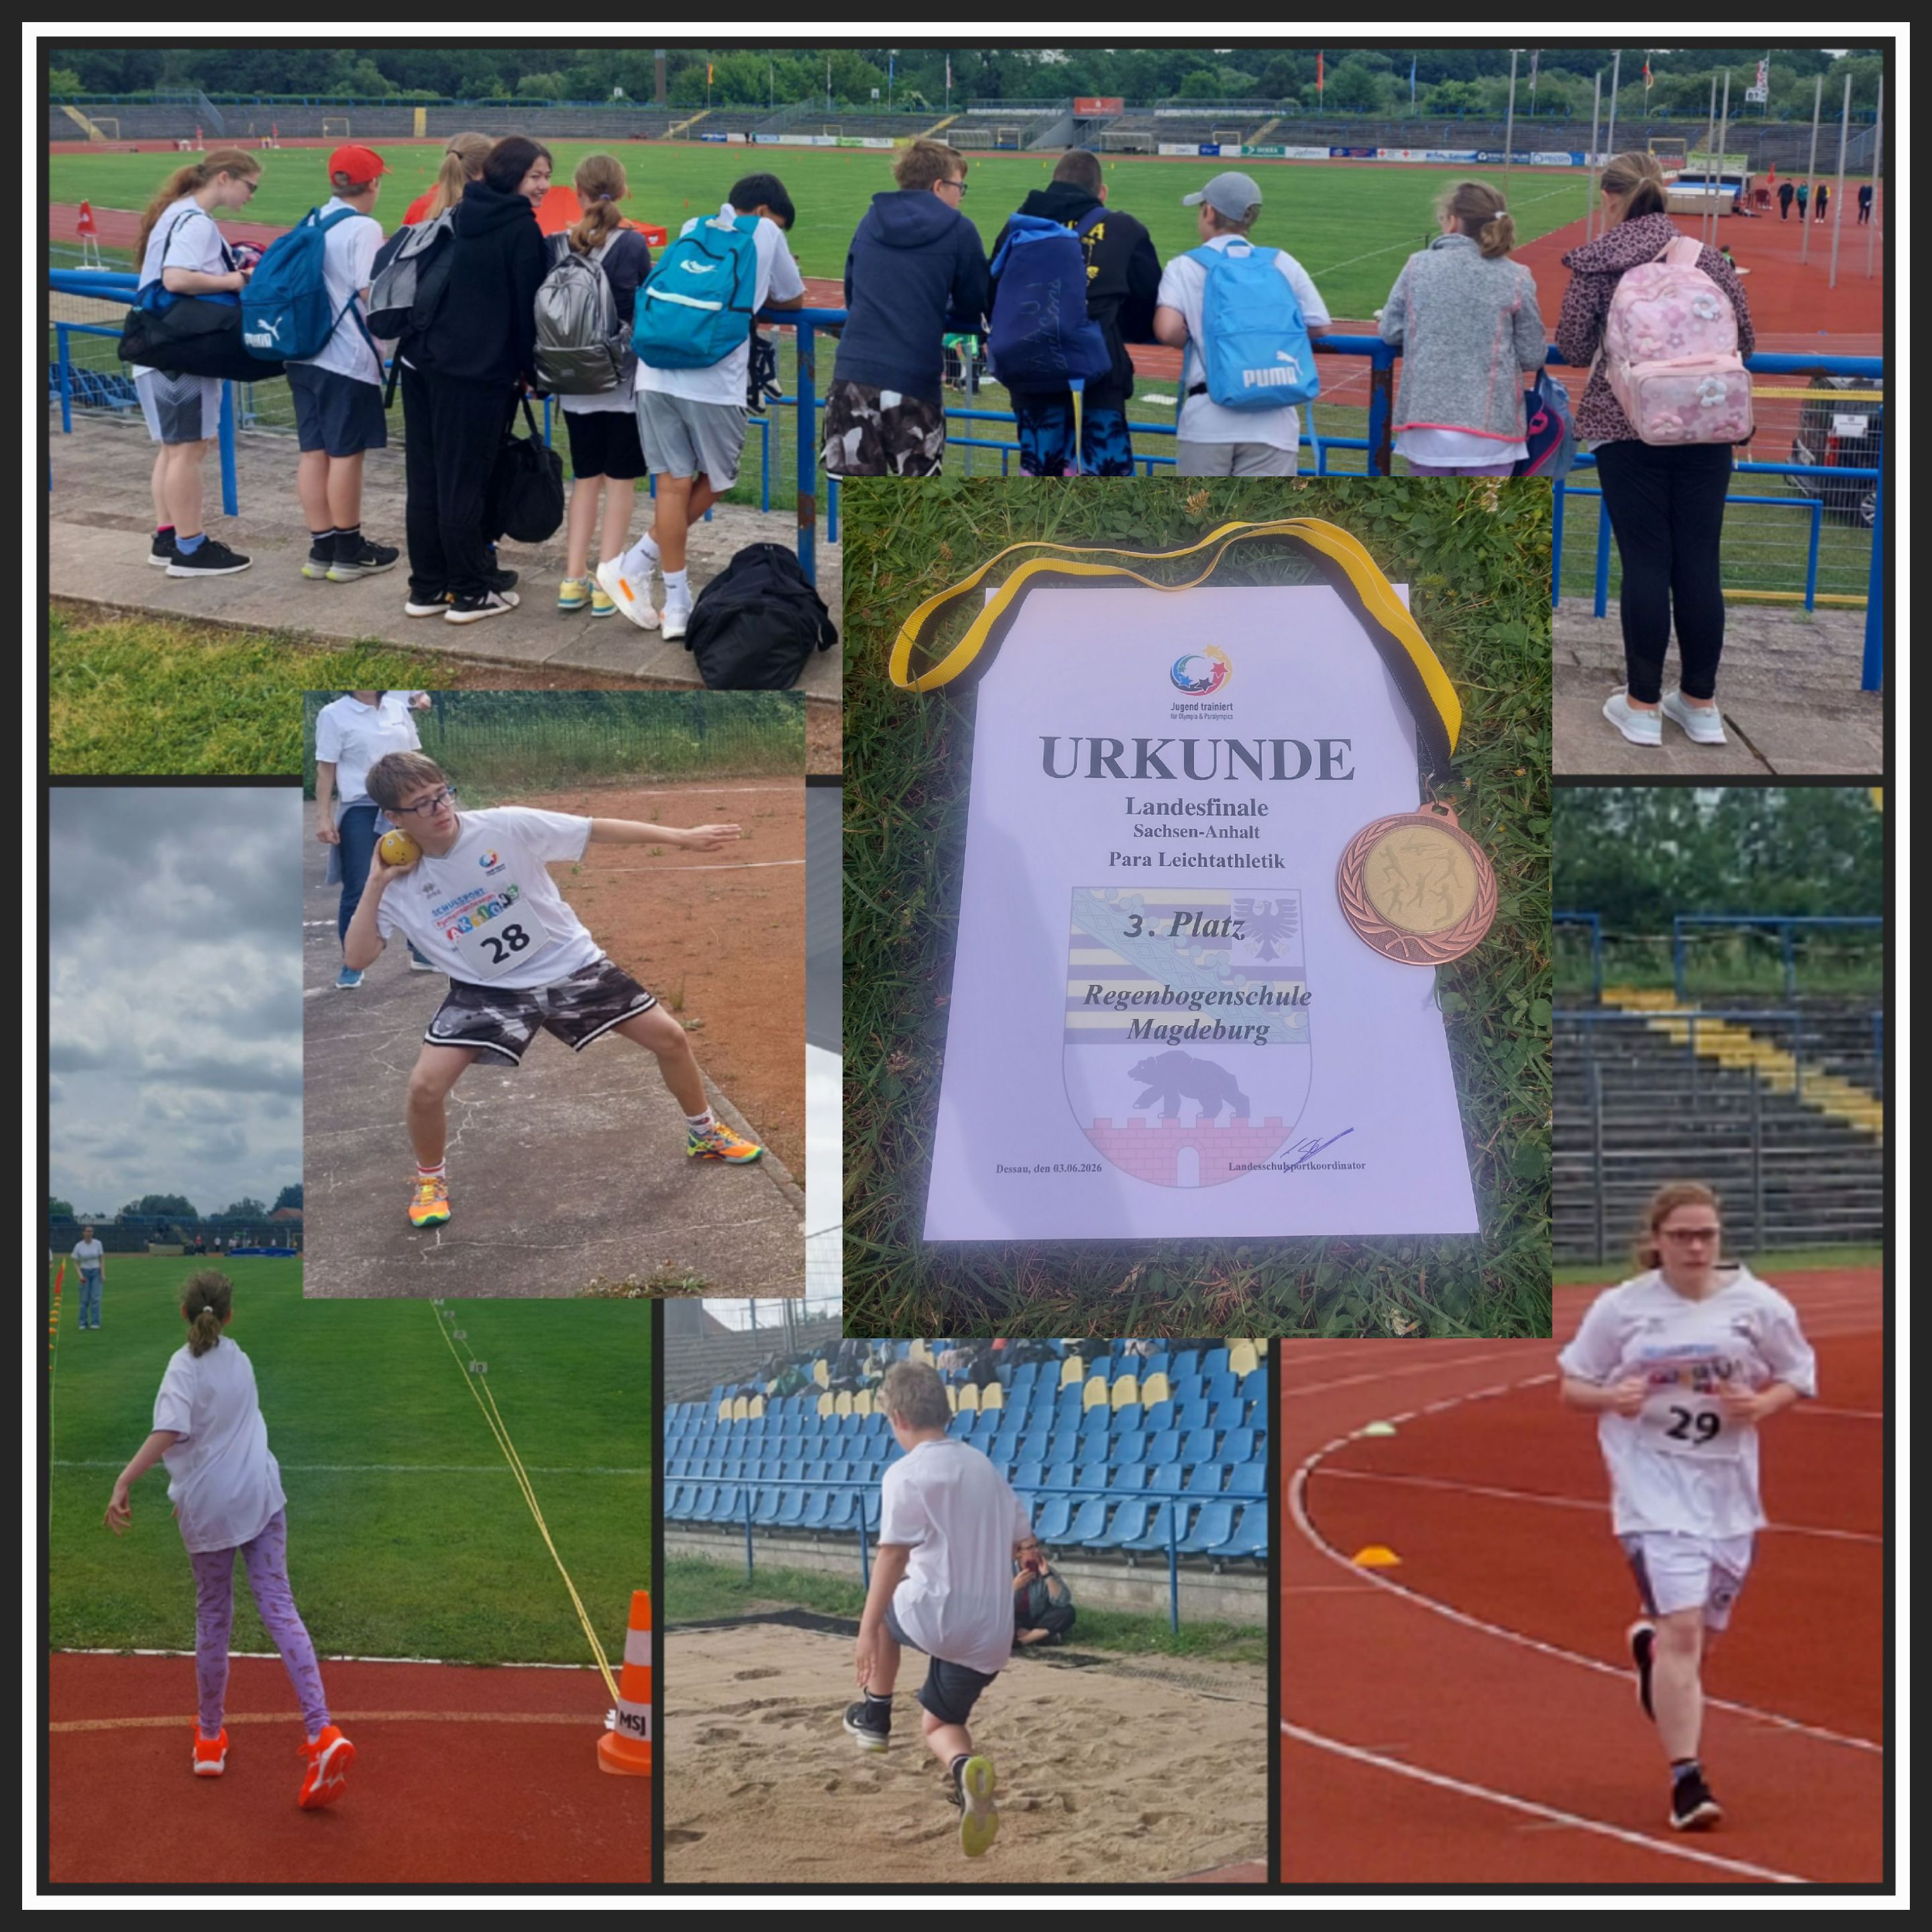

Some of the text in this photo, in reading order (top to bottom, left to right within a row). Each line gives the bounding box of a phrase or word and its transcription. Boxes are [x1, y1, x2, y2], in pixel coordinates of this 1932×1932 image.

[1242, 366, 1298, 388] PUMA
[1171, 702, 1234, 712] Jugend trainiert
[1039, 736, 1355, 782] URKUNDE
[1125, 796, 1269, 817] Landesfinale
[1133, 824, 1260, 839] Sachsen-Anhalt
[1109, 851, 1286, 869] Para Leichtathletik
[431, 888, 484, 917] SCHULSPORT
[1123, 911, 1246, 941] 3. Platz
[480, 924, 530, 964] 28
[1082, 984, 1312, 1011] Regenbogenschule
[1126, 1018, 1271, 1046] Magdeburg
[996, 1163, 1102, 1175] Dessau, den 03.06.2026
[1229, 1161, 1366, 1173] Landesschulsportkoordinator
[1665, 1405, 1721, 1446] 29
[619, 1710, 646, 1737] MSJ
